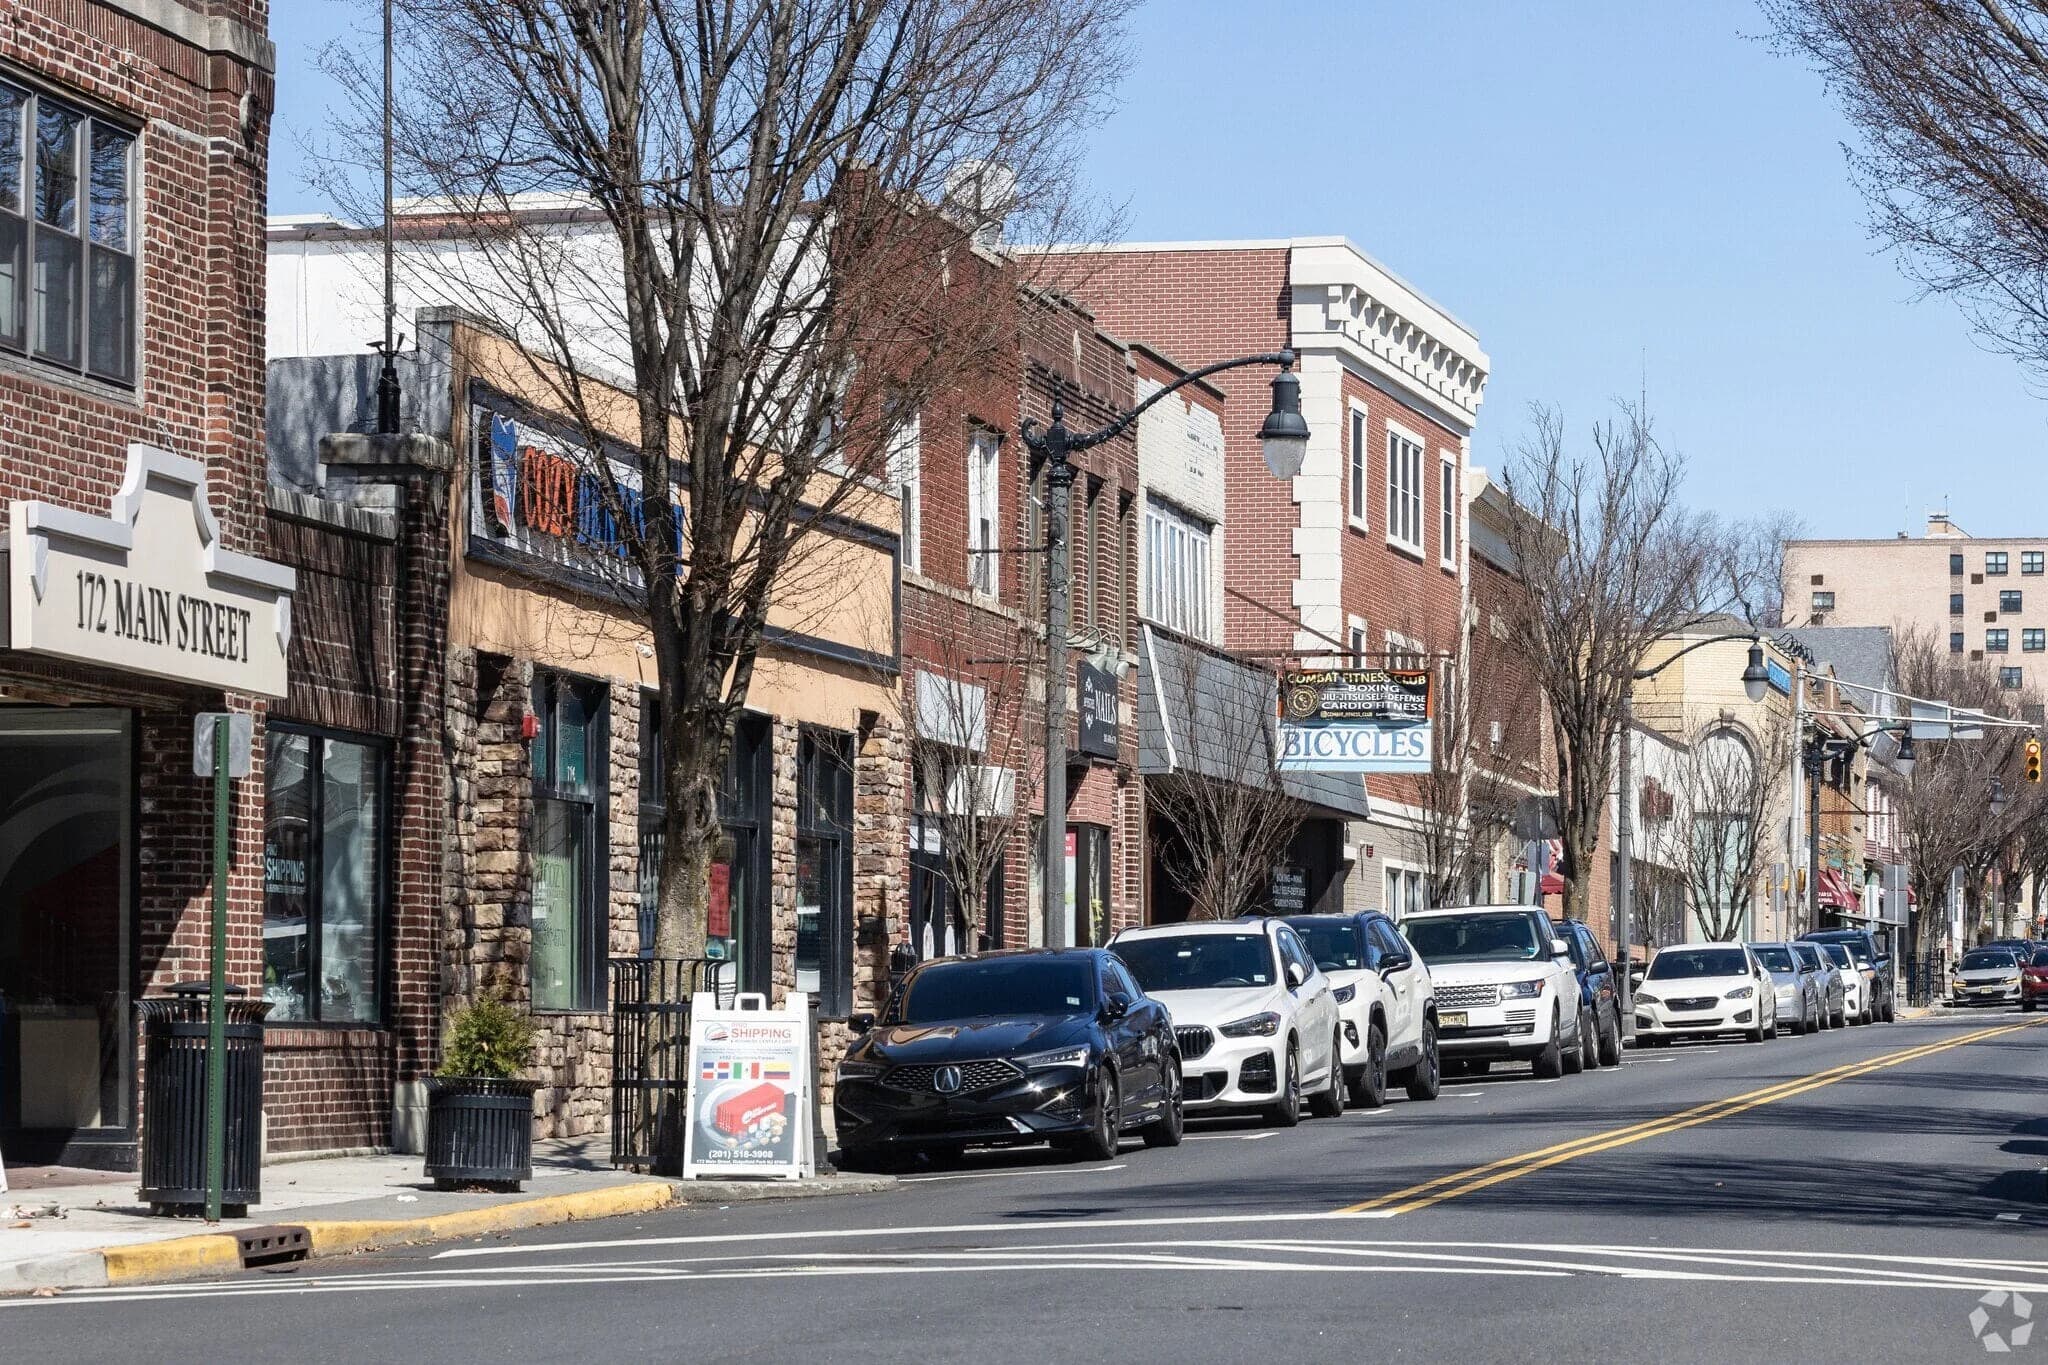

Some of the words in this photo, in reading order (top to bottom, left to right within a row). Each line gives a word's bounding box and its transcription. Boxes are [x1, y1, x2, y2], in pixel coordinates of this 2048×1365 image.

[77, 569, 107, 633] 172
[114, 578, 171, 646] MAIN
[177, 593, 251, 664] STREET
[1287, 672, 1339, 684] COMBAT
[1342, 672, 1391, 683] FITNESS
[1394, 674, 1426, 685] CLUB
[1348, 684, 1400, 693] BOXING
[1321, 693, 1364, 701] JIU-JITSU
[1366, 693, 1426, 703] SELF-DEFENSE
[1095, 689, 1116, 726] NAILS
[1321, 701, 1372, 710] CARDIO
[1375, 701, 1426, 711] FITNESS
[1283, 730, 1425, 757] BICYCLES
[266, 857, 305, 883] SHIPPING
[731, 1028, 792, 1039] SHIPPING
[708, 1150, 731, 1159] (201)
